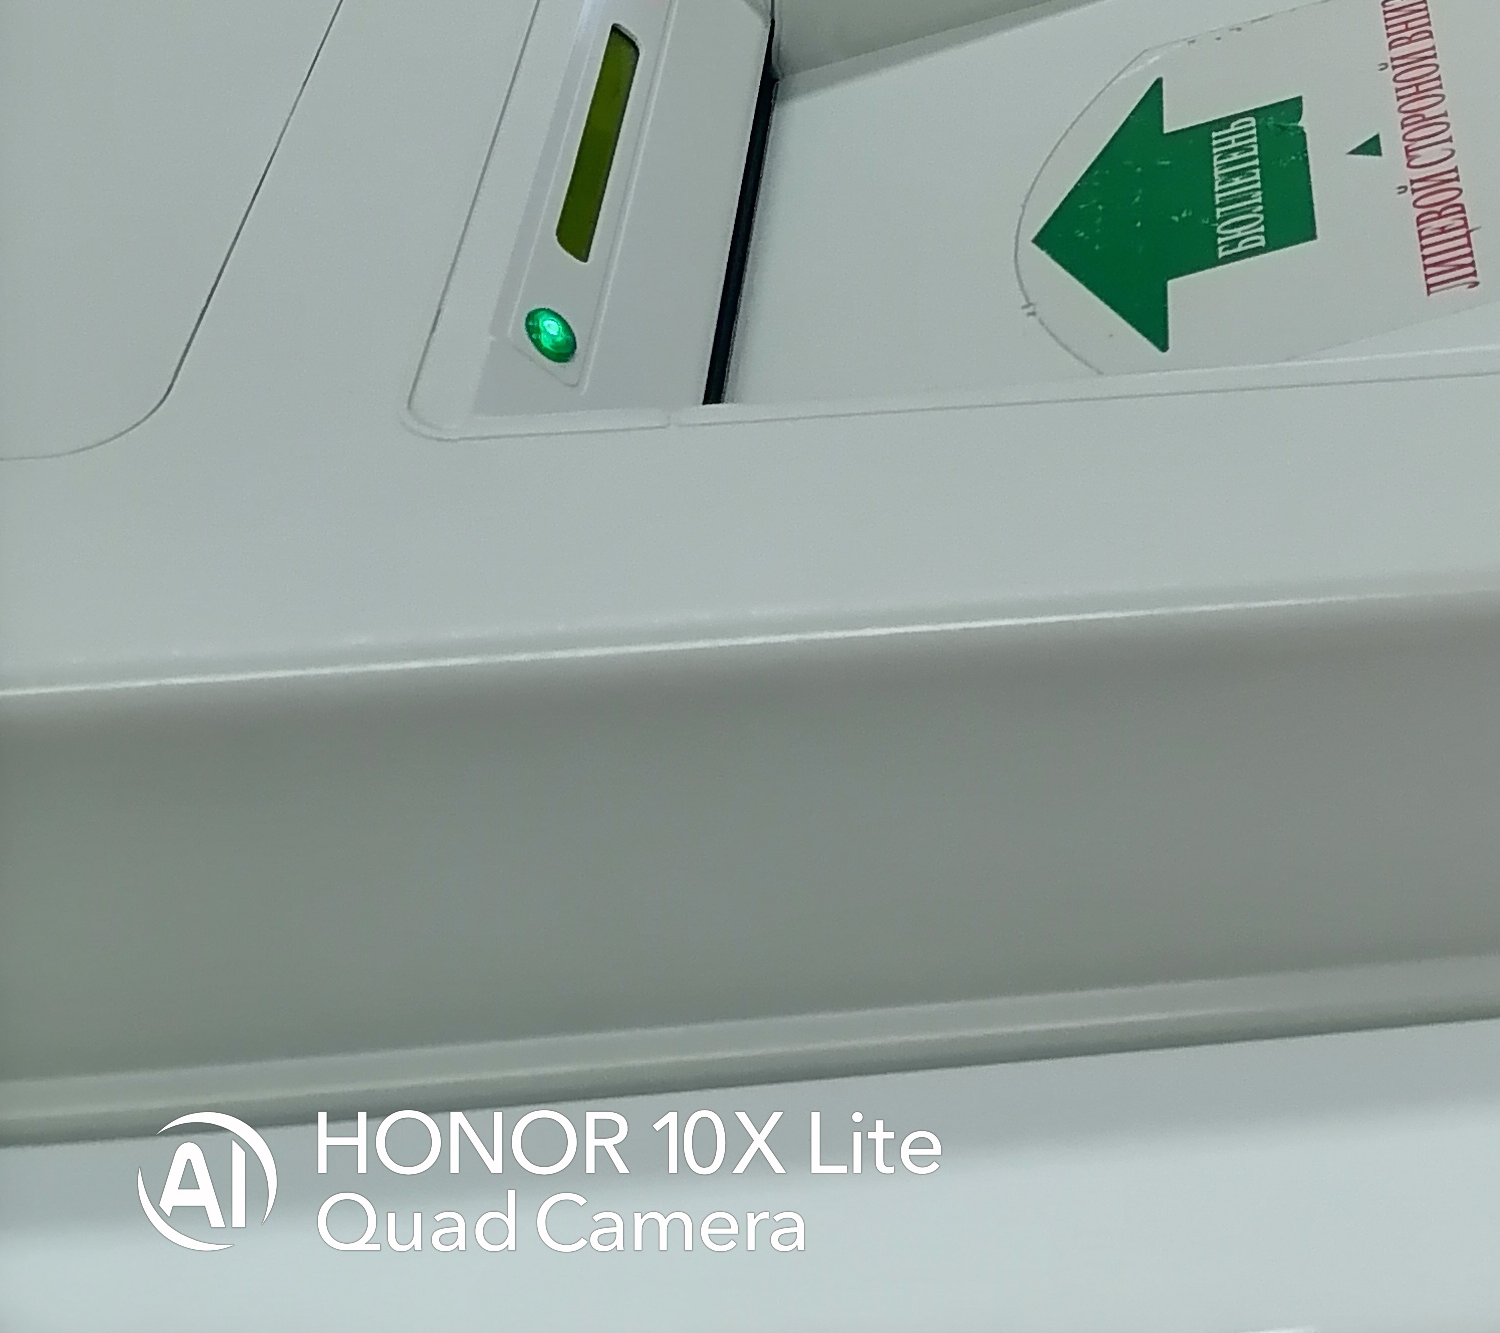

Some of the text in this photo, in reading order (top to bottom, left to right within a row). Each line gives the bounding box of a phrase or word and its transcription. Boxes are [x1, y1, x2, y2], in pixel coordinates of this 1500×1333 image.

[1378, 45, 1457, 170] СТОРОНОЙ
[1211, 116, 1266, 259] БЮЛЛЕТЕНЬ
[1396, 166, 1482, 296] ЛИЦЕВОЙ
